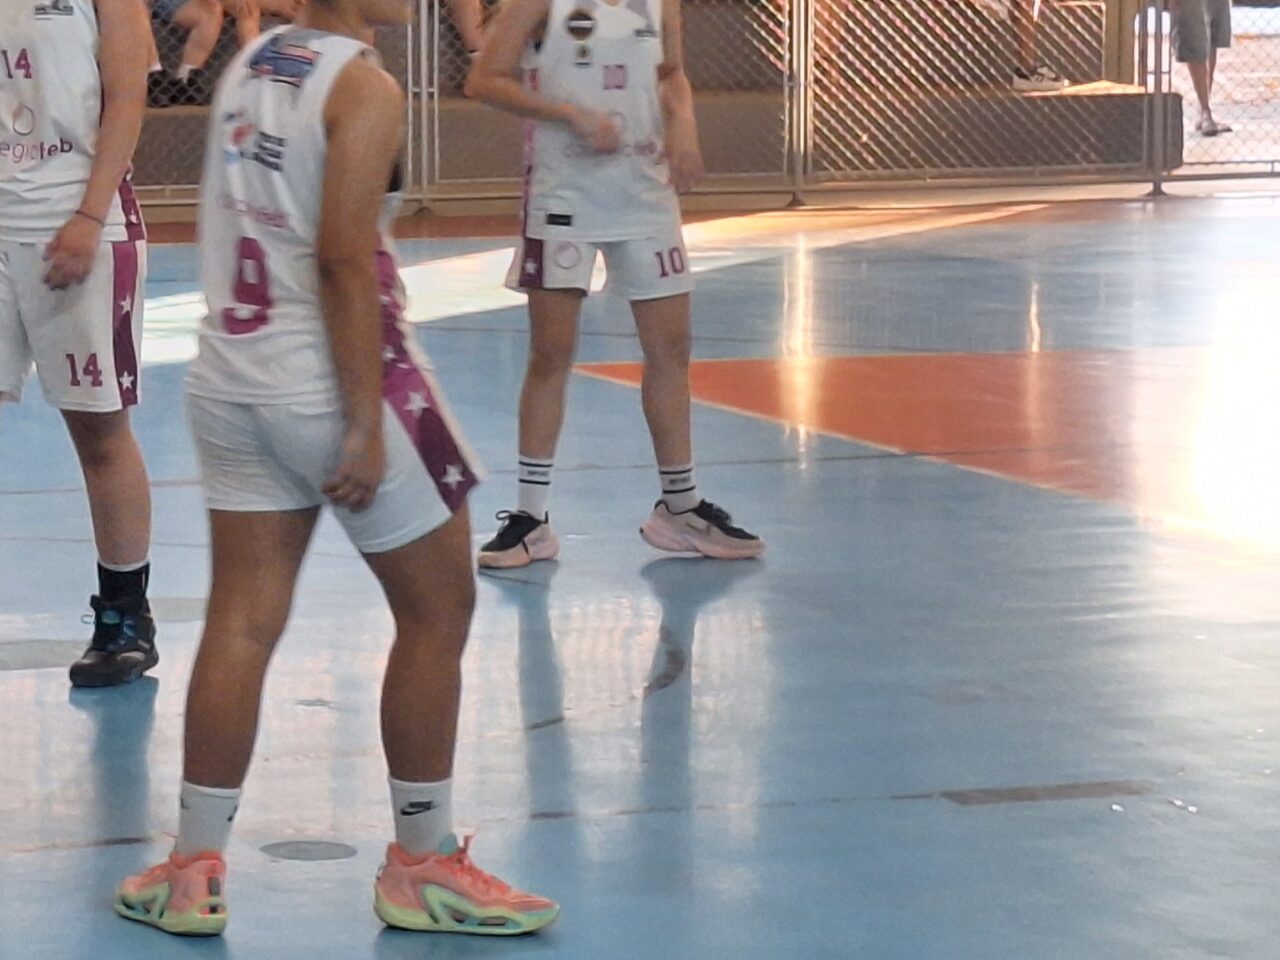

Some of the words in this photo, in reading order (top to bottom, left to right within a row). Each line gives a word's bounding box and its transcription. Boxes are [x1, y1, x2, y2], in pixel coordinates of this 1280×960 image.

[1, 48, 32, 79] 14
[655, 247, 685, 279] 10
[65, 352, 103, 388] 14
